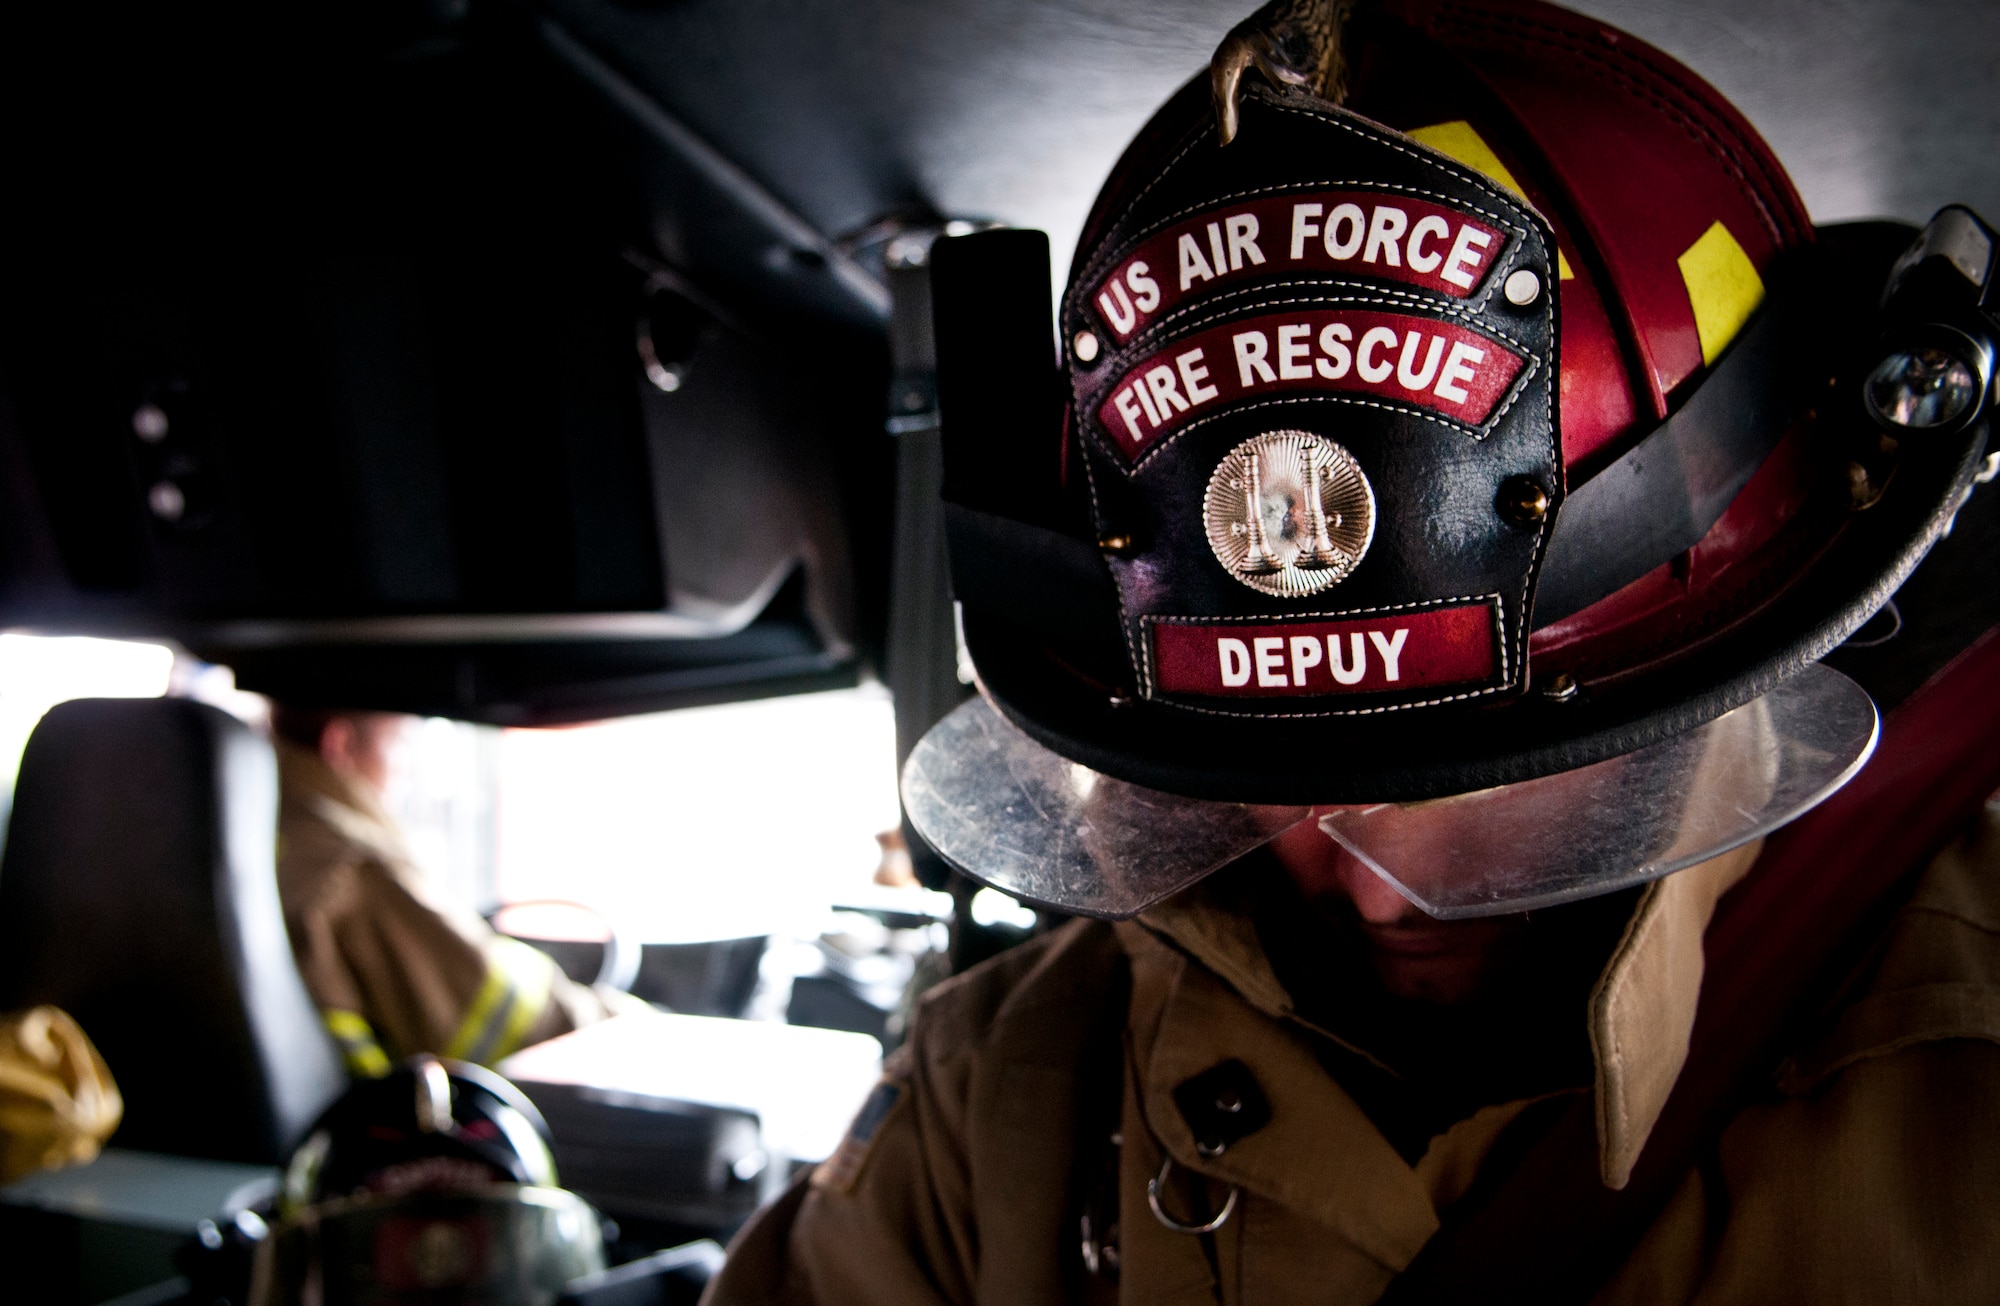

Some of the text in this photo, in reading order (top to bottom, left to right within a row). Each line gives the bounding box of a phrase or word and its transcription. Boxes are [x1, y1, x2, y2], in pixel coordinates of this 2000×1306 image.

[1099, 203, 1493, 335] US AIR FORCE
[1114, 323, 1485, 442] FIRE RESCUE
[1217, 628, 1409, 687] DEPUY
